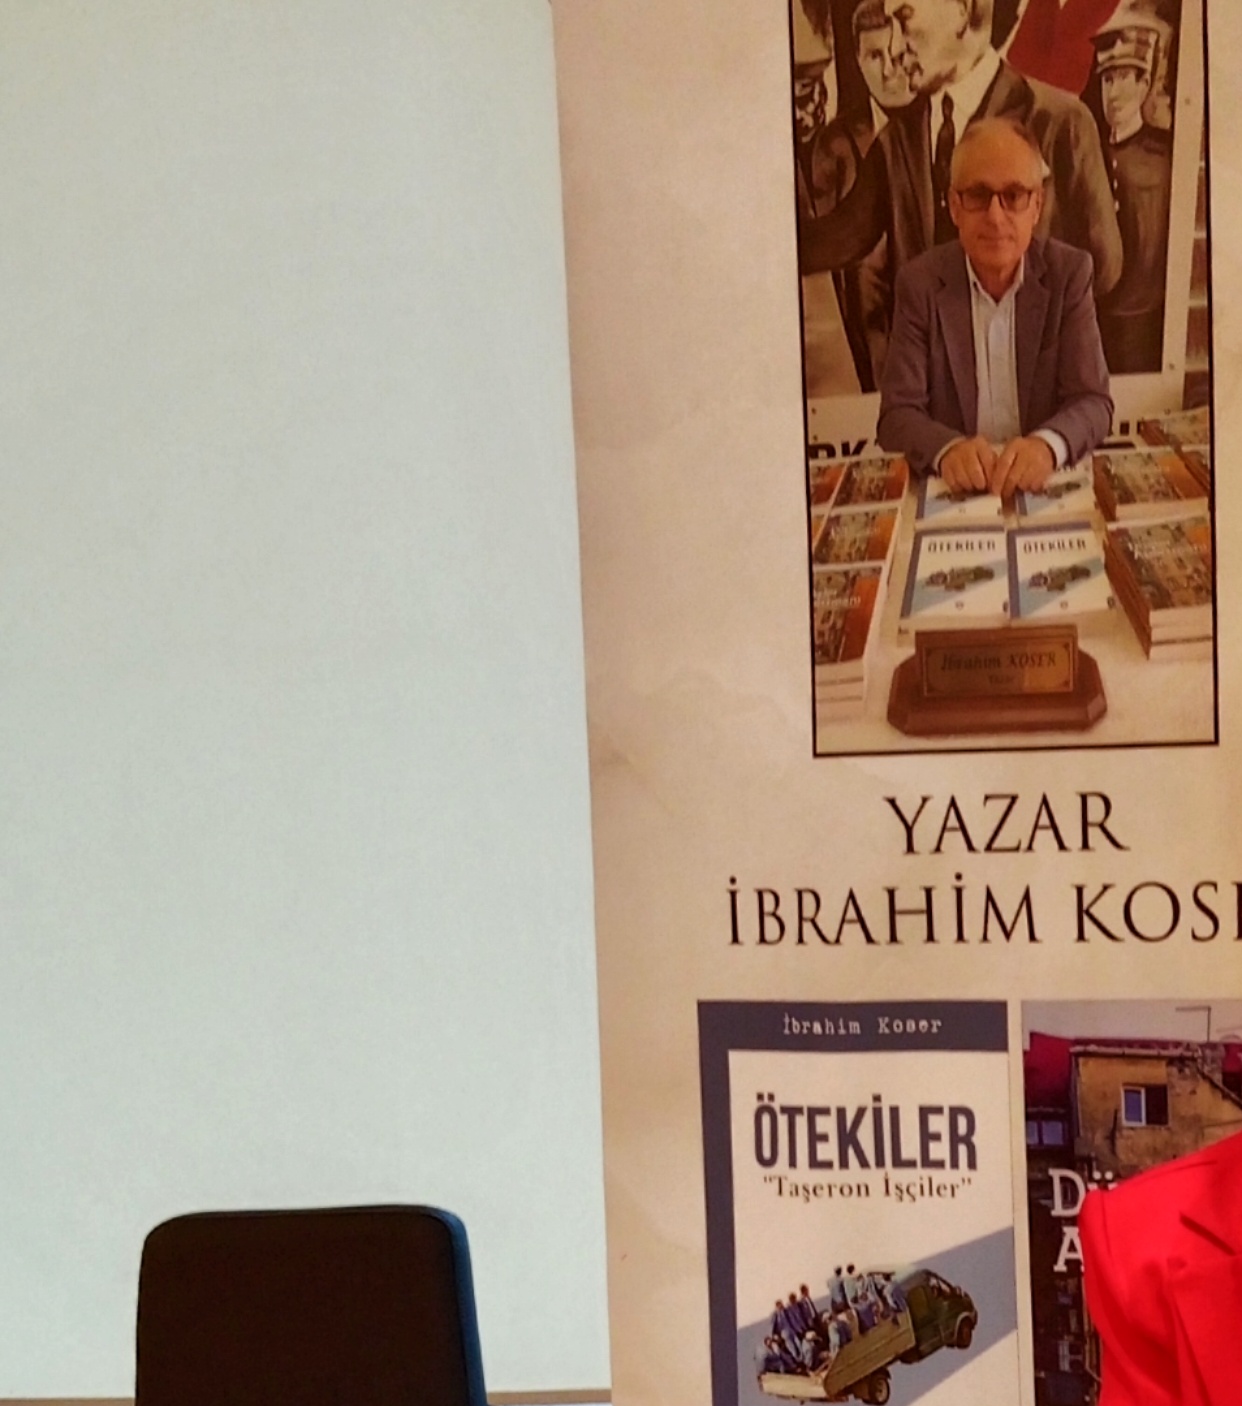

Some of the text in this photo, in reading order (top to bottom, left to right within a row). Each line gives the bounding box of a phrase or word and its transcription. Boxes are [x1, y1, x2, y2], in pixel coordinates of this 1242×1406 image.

[883, 792, 1130, 854] YAZAR
[726, 872, 1042, 945] İBRAHİM
[783, 1013, 943, 1035] İbrahim Koser
[753, 1092, 978, 1171] ÖTEKİLER
